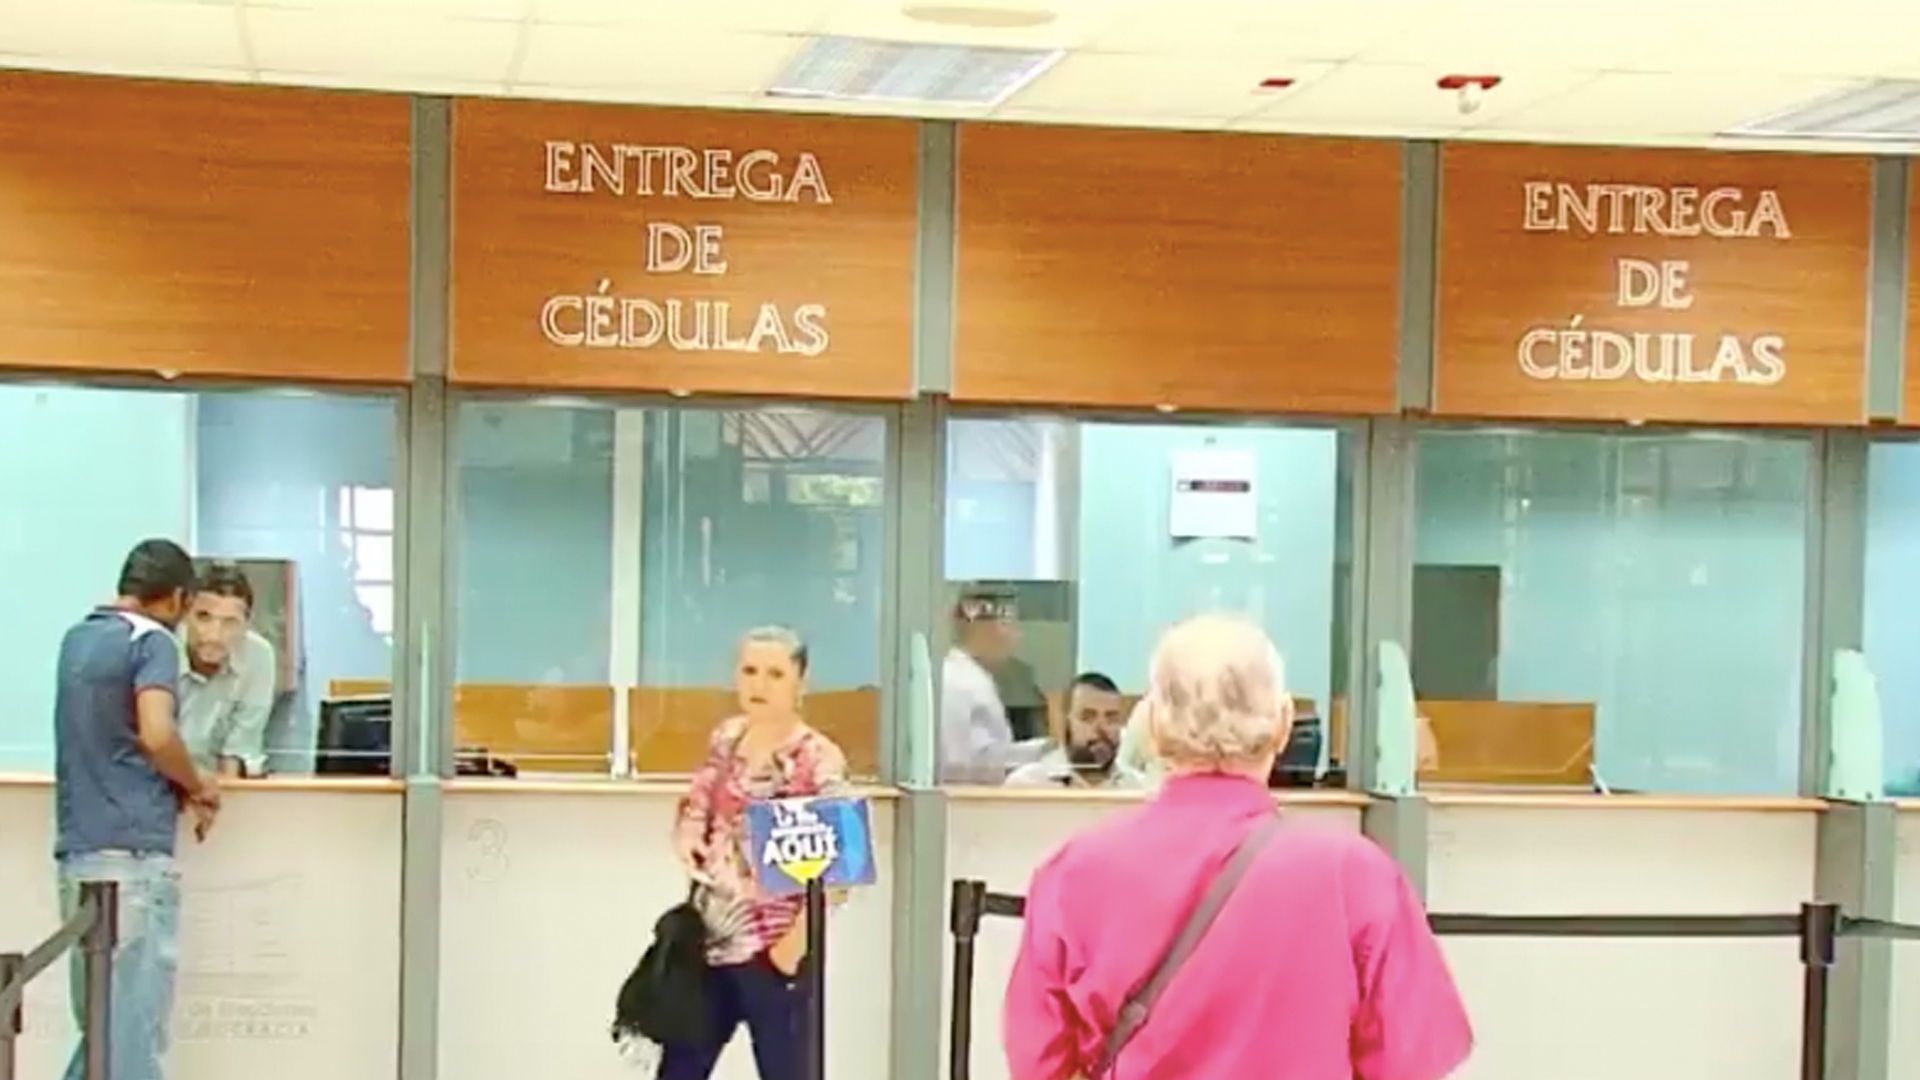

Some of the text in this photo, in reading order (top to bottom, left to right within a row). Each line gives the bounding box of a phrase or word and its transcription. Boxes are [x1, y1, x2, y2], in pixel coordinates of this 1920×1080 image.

[543, 140, 833, 204] ENTREGA
[1522, 181, 1792, 239] ENTREGA
[645, 221, 728, 275] DE
[1616, 257, 1694, 310] DE
[541, 277, 830, 357] CÉDULAS
[1517, 313, 1786, 386] CÉDULAS
